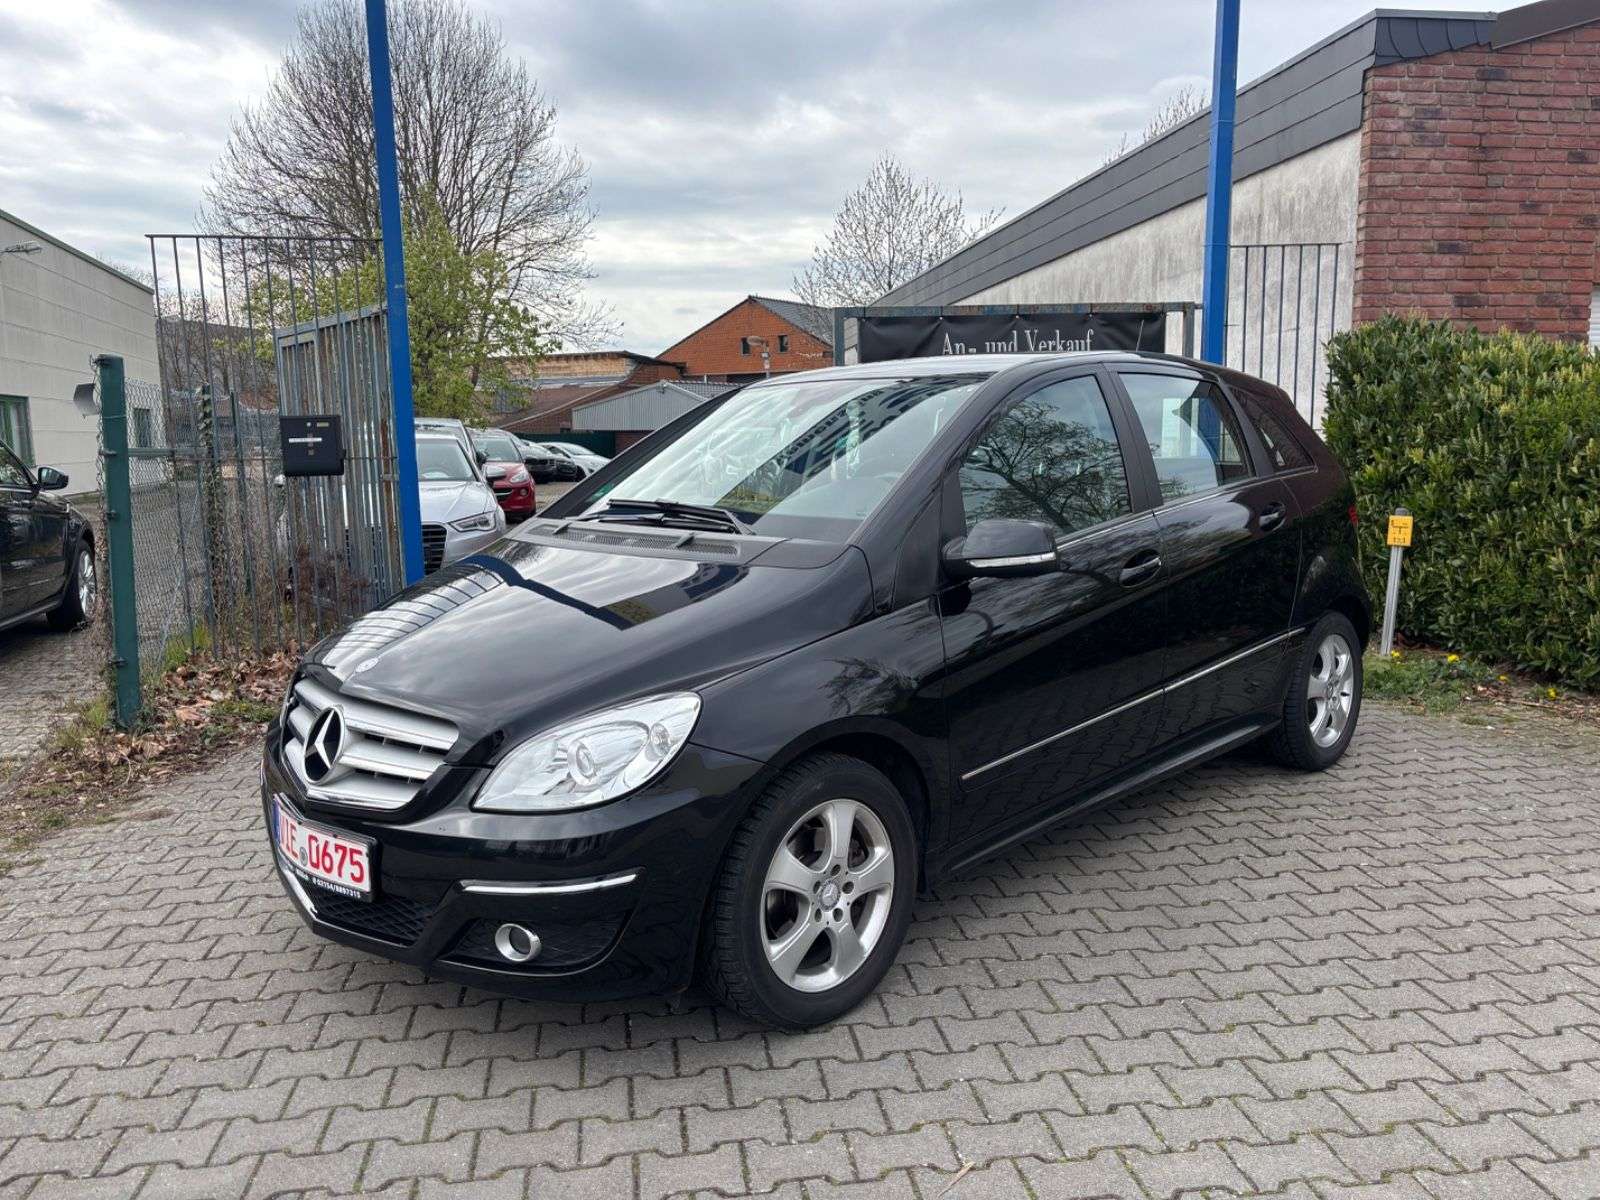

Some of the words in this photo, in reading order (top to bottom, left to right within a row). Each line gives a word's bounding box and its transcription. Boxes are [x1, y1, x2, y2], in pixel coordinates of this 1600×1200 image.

[943, 332, 977, 354] An-
[985, 330, 1018, 352] und
[1025, 328, 1094, 352] Verkauf
[307, 834, 365, 883] 0675
